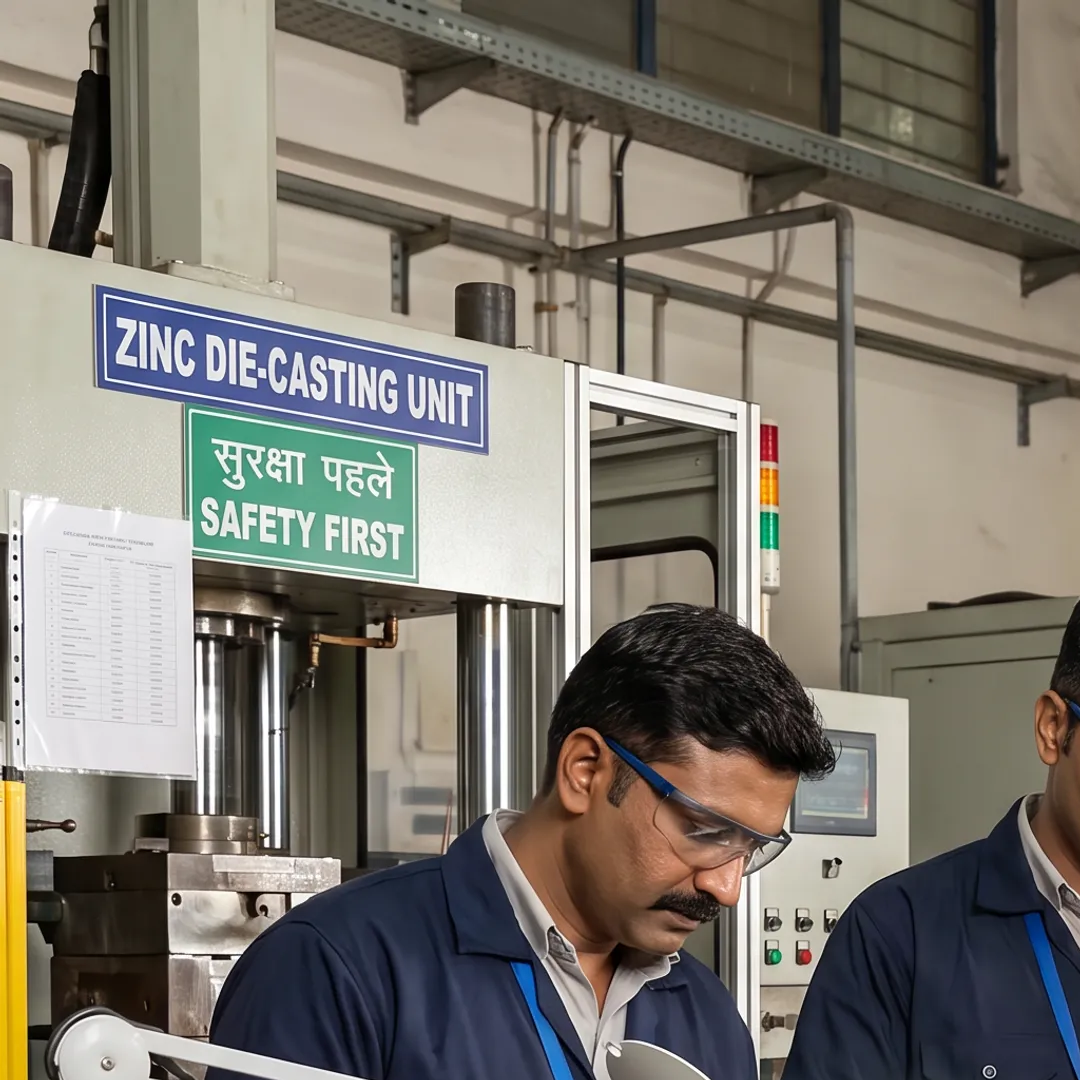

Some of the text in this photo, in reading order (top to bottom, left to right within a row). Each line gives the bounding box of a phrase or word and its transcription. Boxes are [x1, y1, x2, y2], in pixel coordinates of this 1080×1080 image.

[115, 316, 474, 428] ZINC DIE-CASTING UNIT
[210, 437, 395, 500] सुरक्षा पहले
[200, 496, 405, 561] SAFETY FIRST
